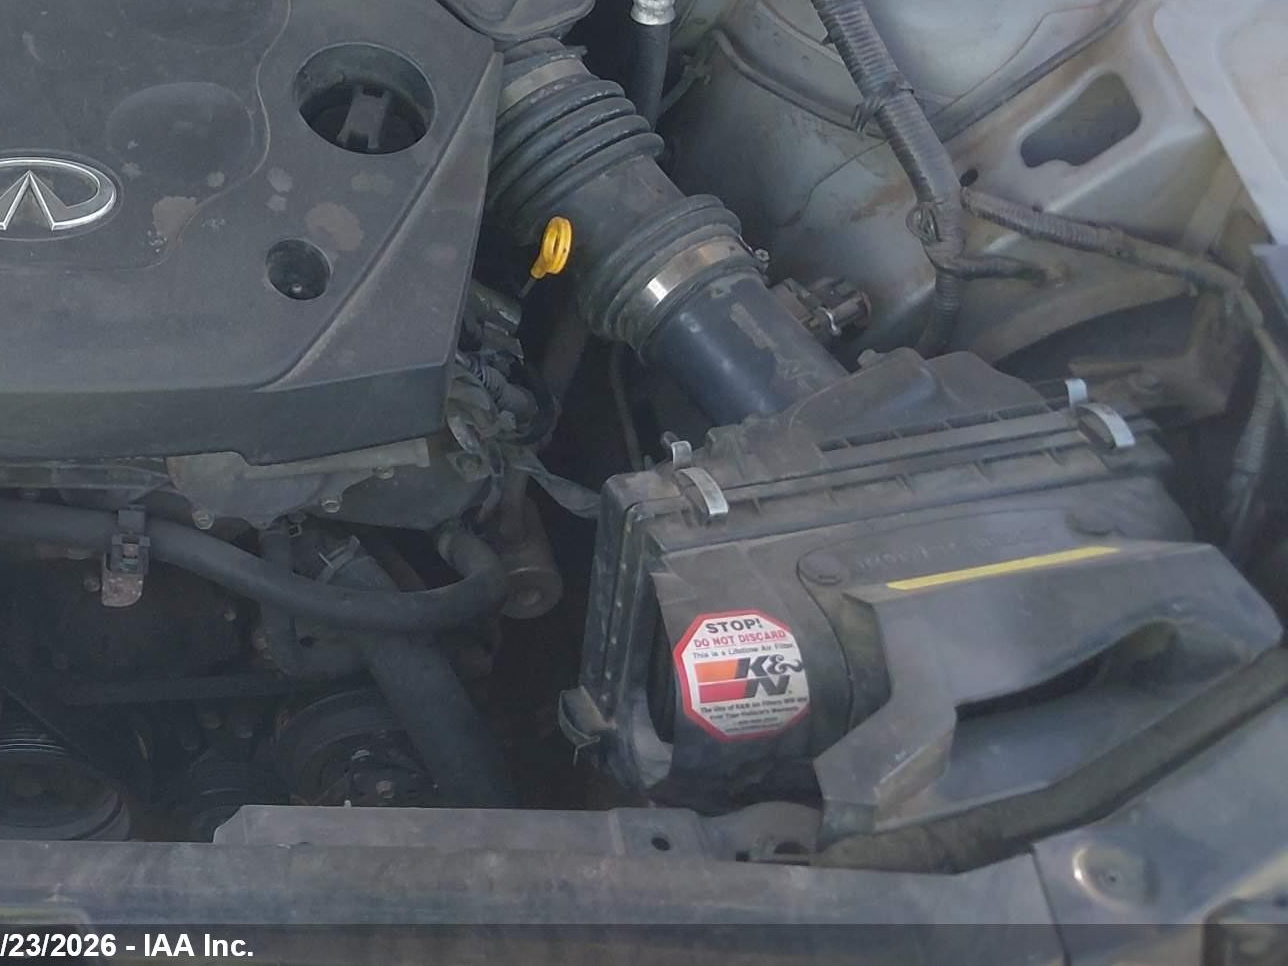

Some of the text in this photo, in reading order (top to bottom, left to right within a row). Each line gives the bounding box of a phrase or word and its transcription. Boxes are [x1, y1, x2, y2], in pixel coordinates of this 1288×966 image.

[705, 618, 763, 634] STOP!
[694, 630, 787, 648] DO NOT DISCARD
